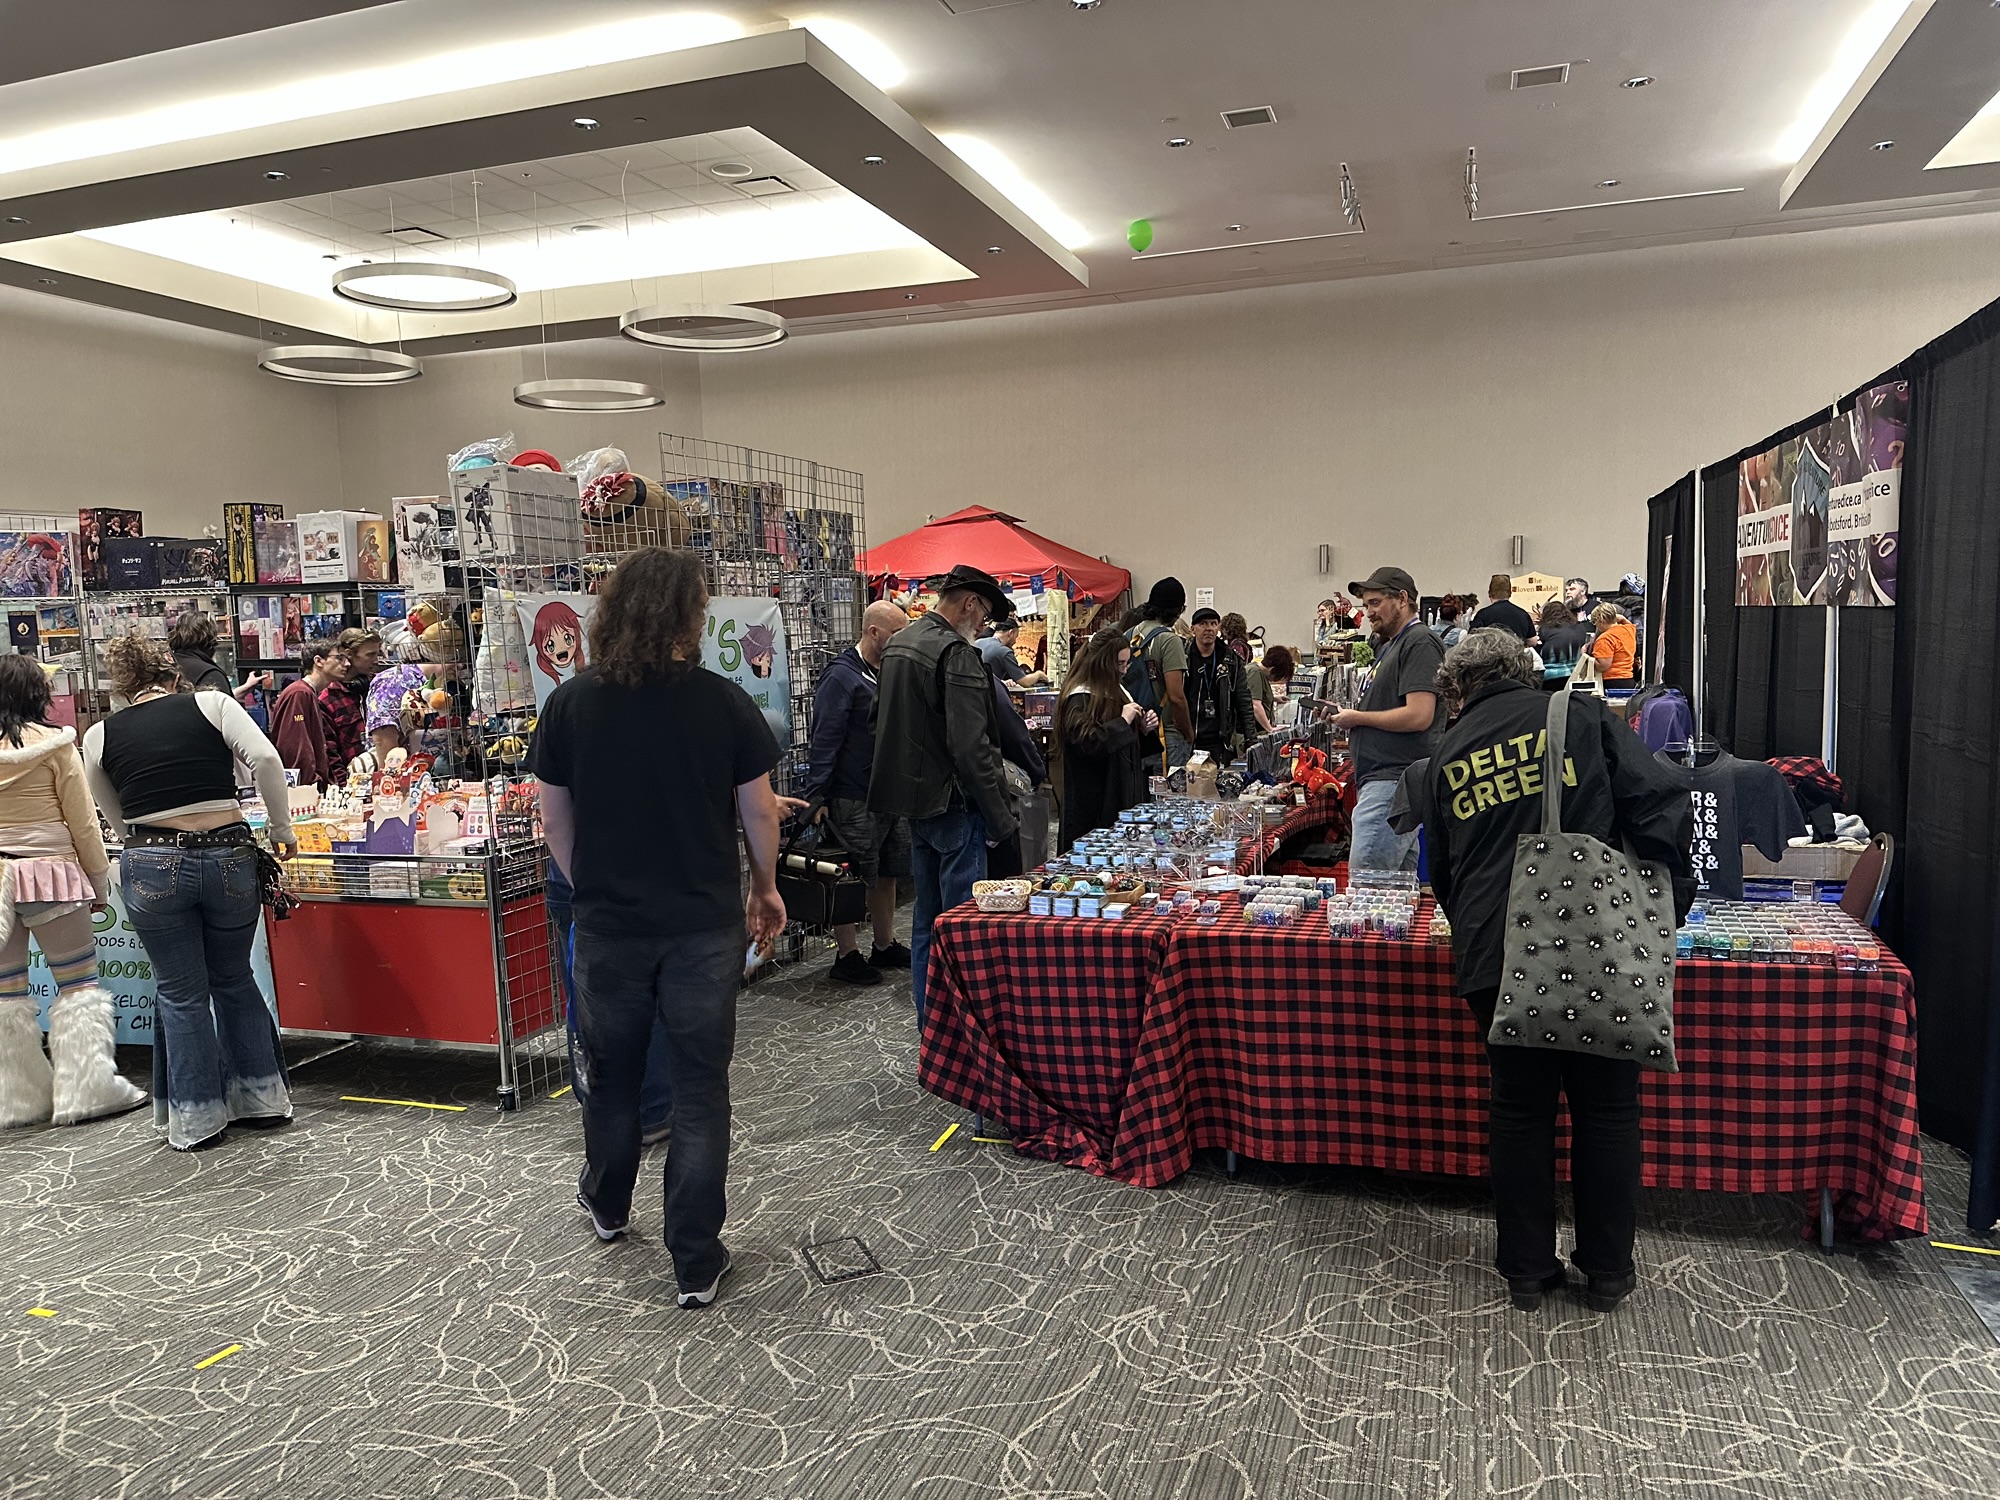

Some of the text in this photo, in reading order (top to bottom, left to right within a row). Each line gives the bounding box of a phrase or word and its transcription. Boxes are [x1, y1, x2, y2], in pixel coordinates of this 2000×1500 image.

[707, 615, 741, 672] 'S
[1452, 757, 1578, 820] GREEN
[1690, 791, 1718, 807] R&
[1693, 807, 1718, 823] K&
[1693, 823, 1718, 839] N&
[1691, 854, 1719, 869] S&
[97, 960, 151, 980] 100%
